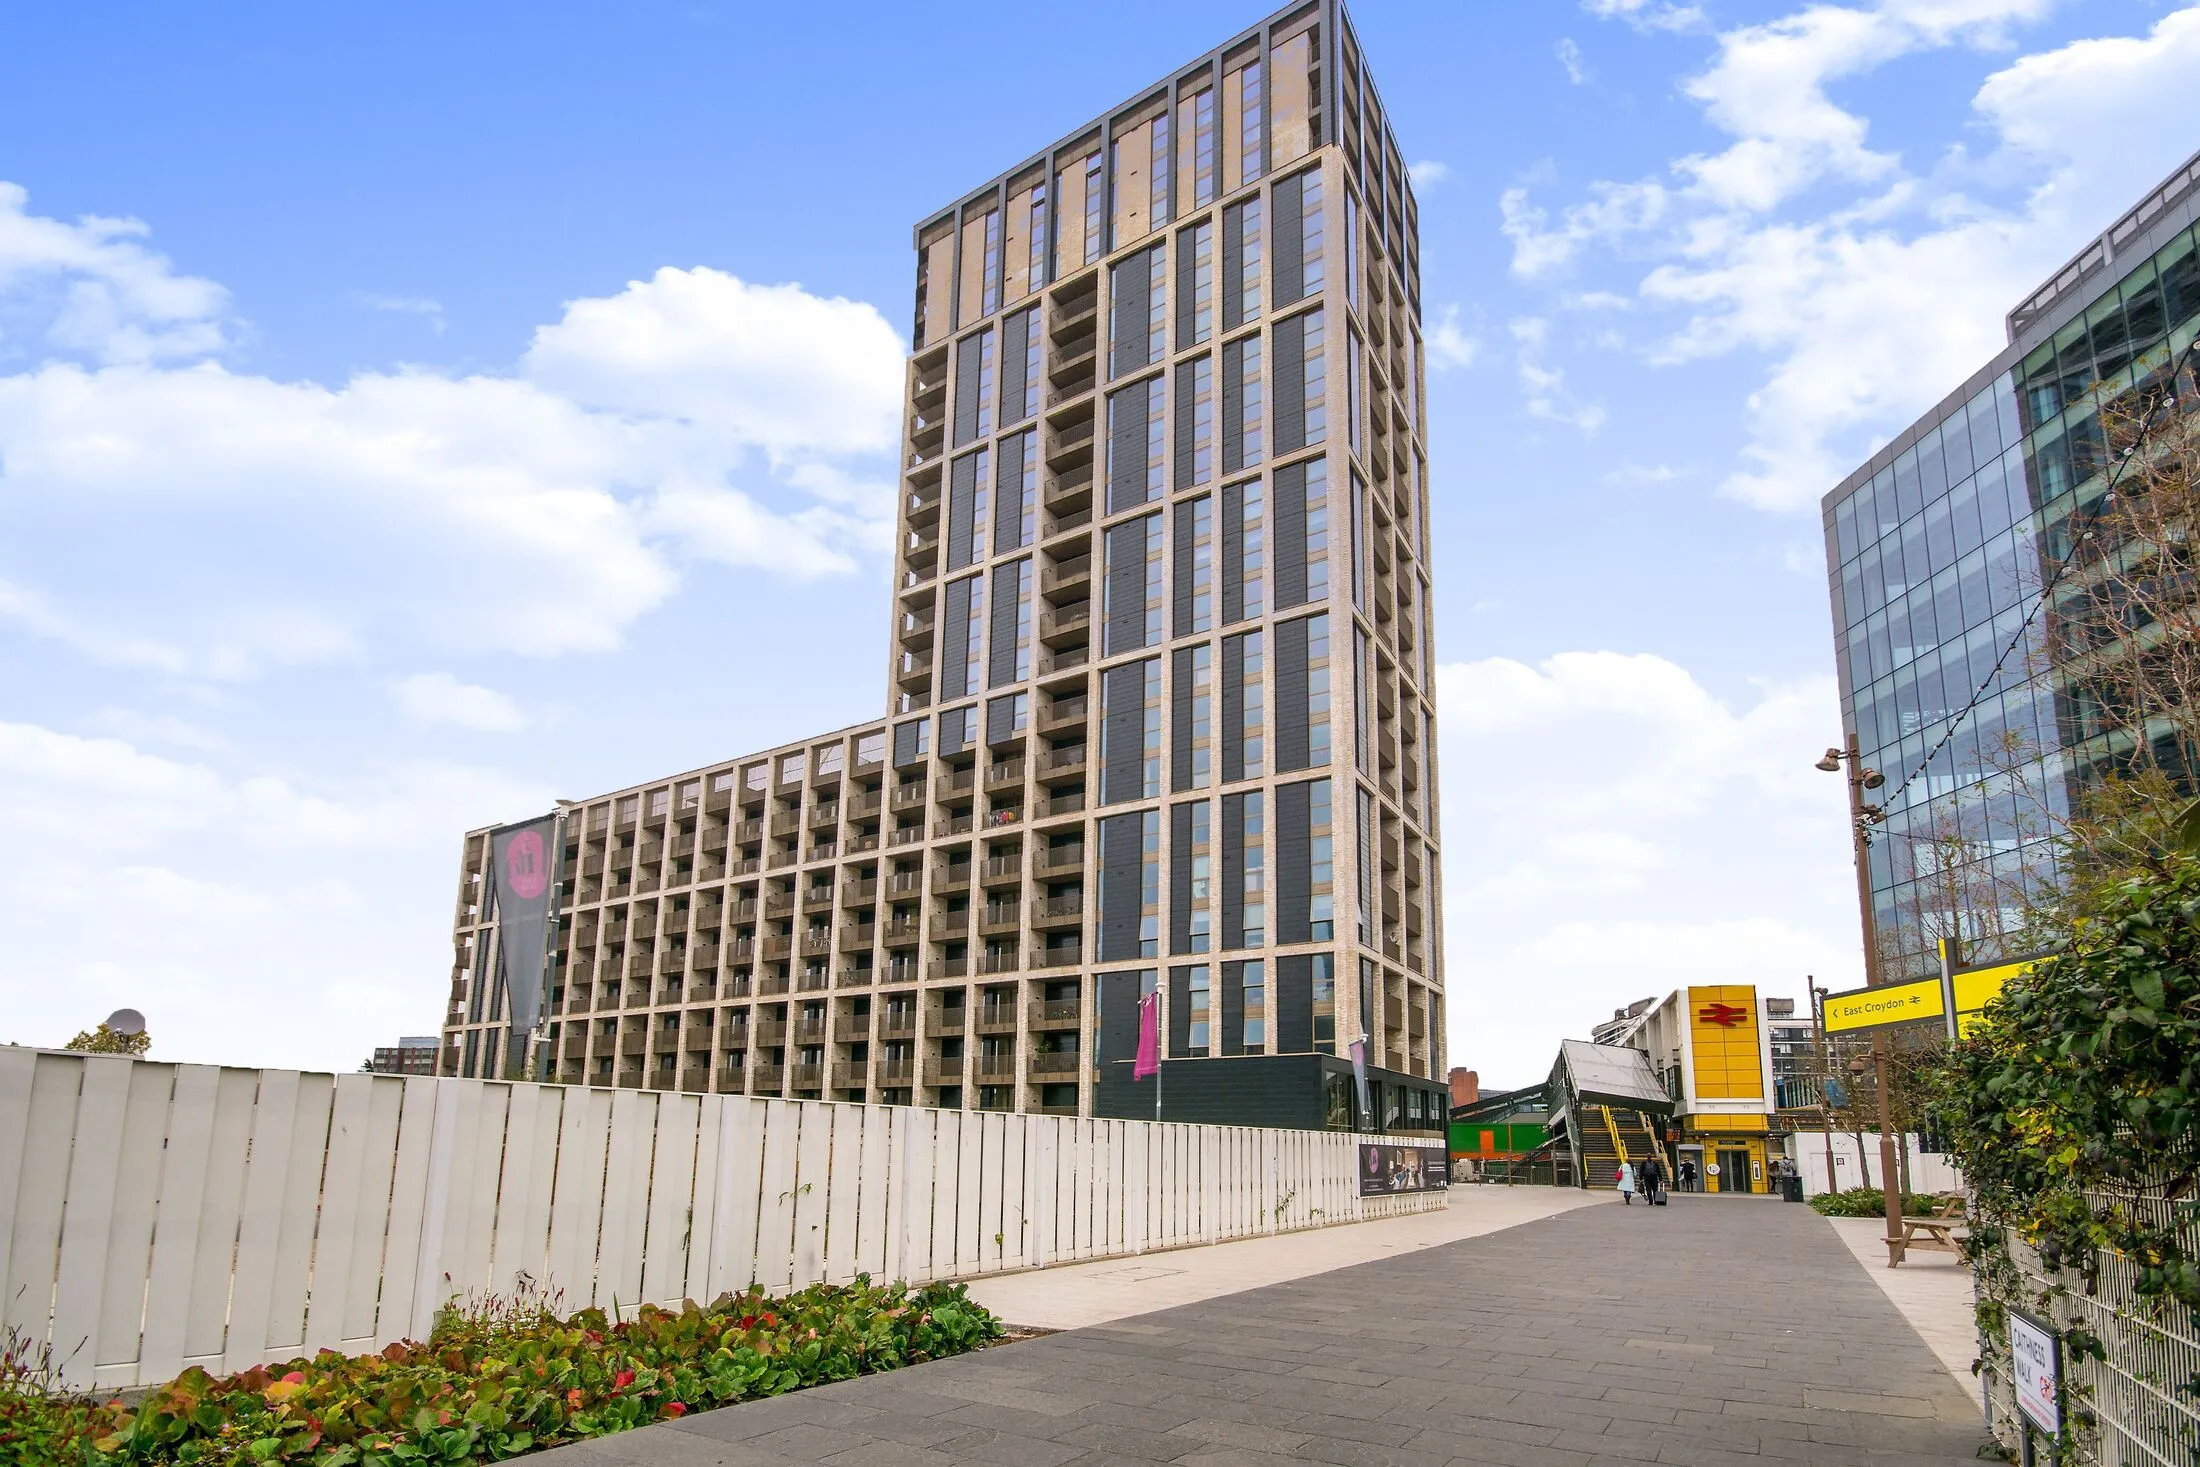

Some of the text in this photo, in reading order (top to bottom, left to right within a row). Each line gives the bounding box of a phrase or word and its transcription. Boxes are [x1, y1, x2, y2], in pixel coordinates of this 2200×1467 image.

[1844, 999, 1904, 1016] East Croydon
[2013, 1327, 2046, 1368] CAITHNESS
[2015, 1356, 2033, 1387] WALK
